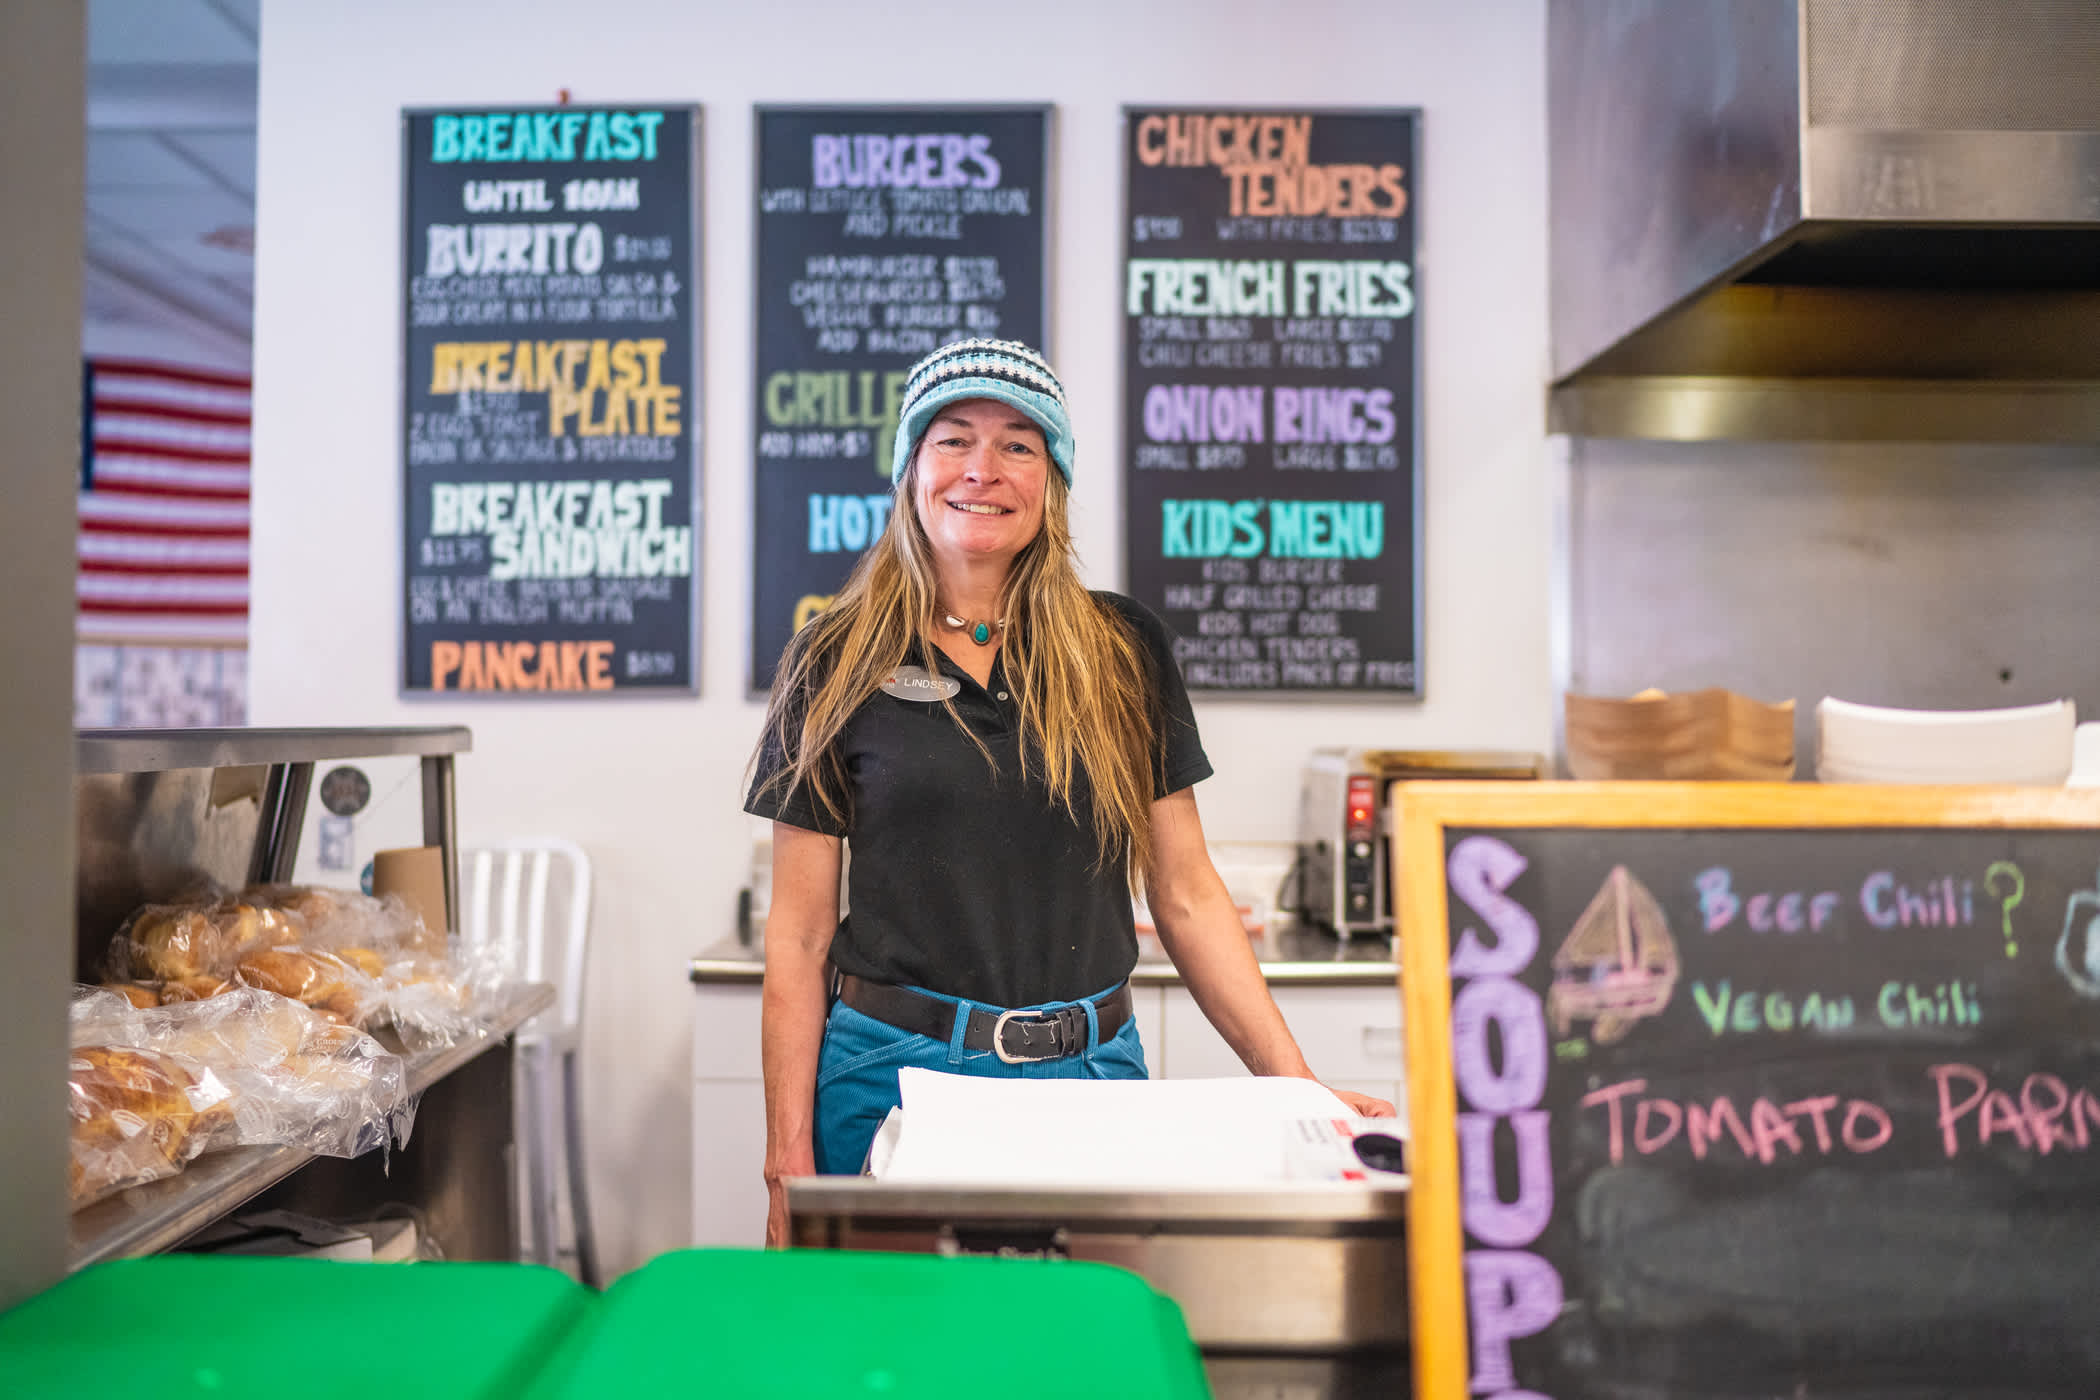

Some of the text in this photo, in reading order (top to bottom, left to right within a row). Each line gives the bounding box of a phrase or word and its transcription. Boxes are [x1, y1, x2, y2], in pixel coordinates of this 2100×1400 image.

[431, 112, 665, 163] BREAKFAST
[811, 133, 1002, 188] BURGERS
[1137, 114, 1312, 167] CHICKEN
[463, 177, 640, 212] UNTIL 10AM
[1221, 163, 1407, 218] TENDERS
[425, 222, 604, 278] BURRITO
[1128, 258, 1415, 318] FRENCH FRIES
[430, 338, 667, 394] BREAKFAST
[550, 384, 682, 436] PLATE
[766, 371, 906, 427] GRILLE
[1144, 385, 1396, 444] ONION RINGS
[430, 480, 673, 535] BREAKFAST
[808, 494, 893, 553] HOT
[1270, 500, 1384, 559] MENU
[489, 525, 691, 581] SANDWICH
[431, 640, 615, 692] PANCAKE
[903, 677, 953, 691] LINDSEY
[1860, 868, 1973, 928] Chili
[1983, 860, 2025, 958] ?
[1877, 979, 1980, 1029] Chili
[1447, 836, 1564, 1400] SOUP
[1581, 1078, 1893, 1165] TOMATO
